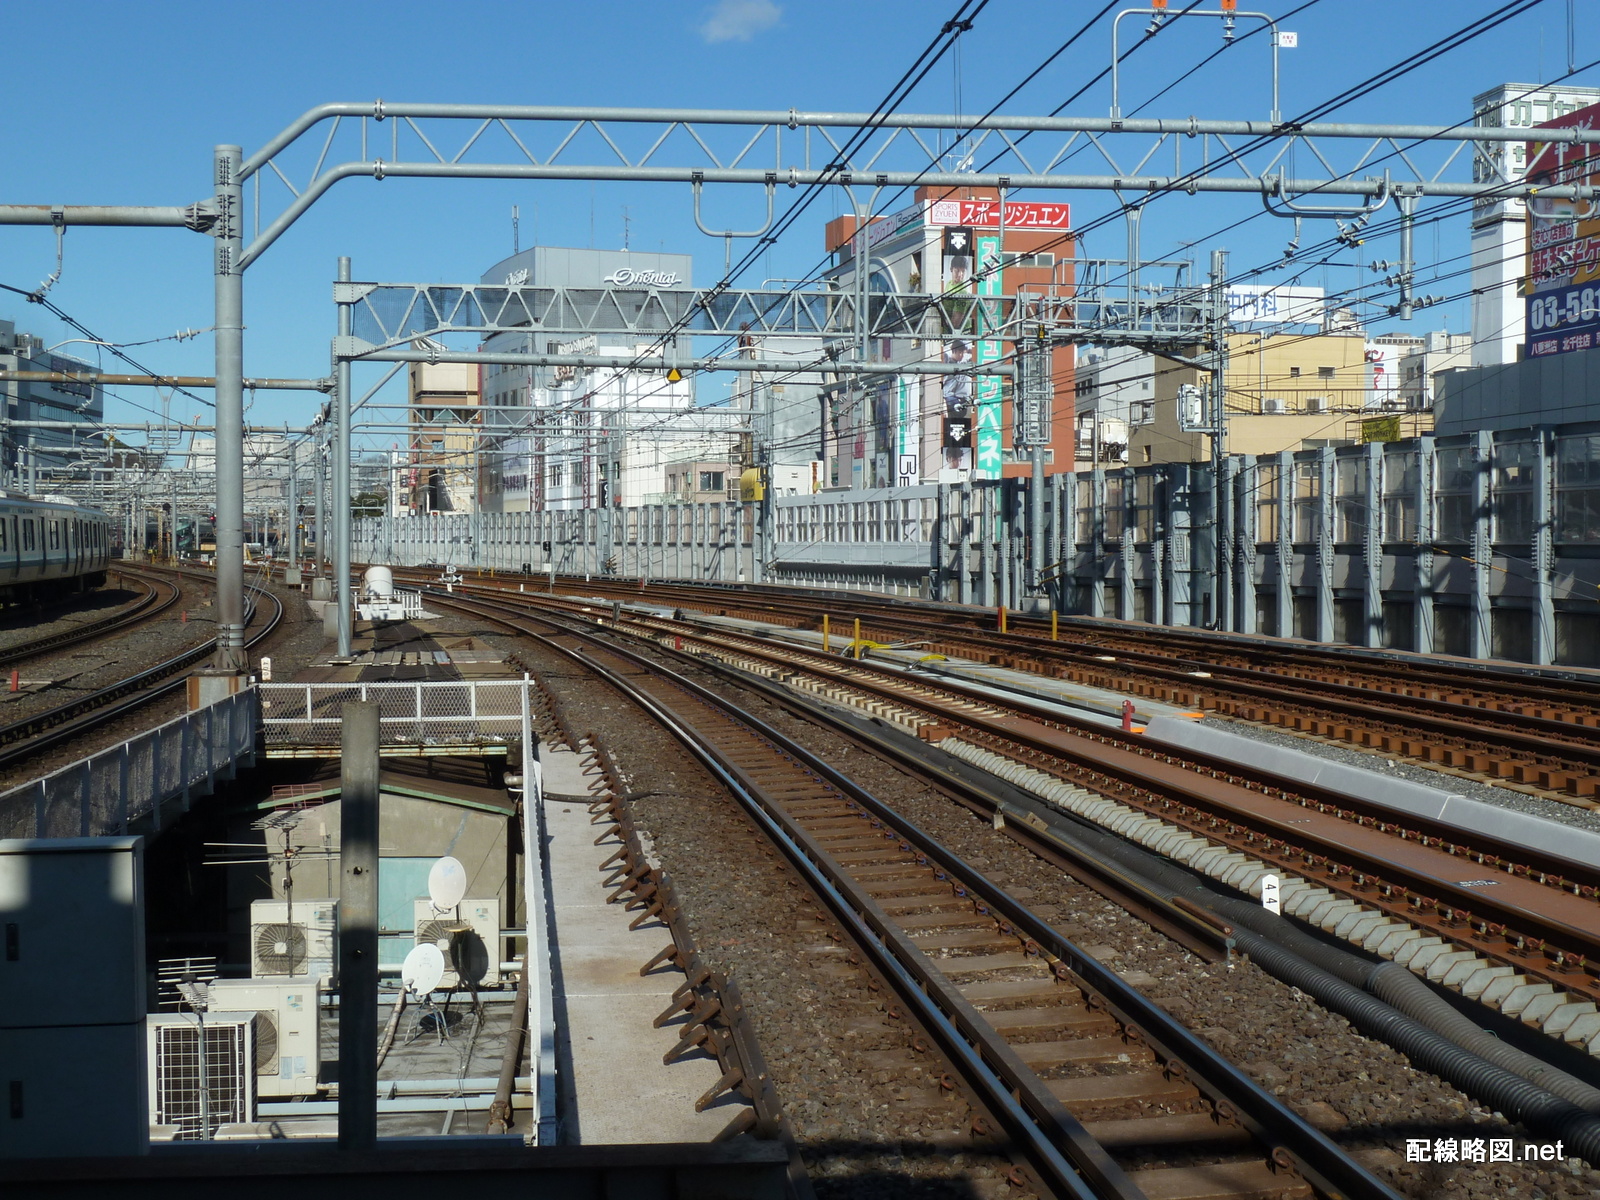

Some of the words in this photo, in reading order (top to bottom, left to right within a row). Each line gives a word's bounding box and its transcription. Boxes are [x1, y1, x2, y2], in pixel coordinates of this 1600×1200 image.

[934, 210, 958, 218] ZYUEN
[962, 203, 1067, 226] スポーツジュエン
[604, 267, 682, 287] Oriental
[1208, 291, 1277, 316] 中内科
